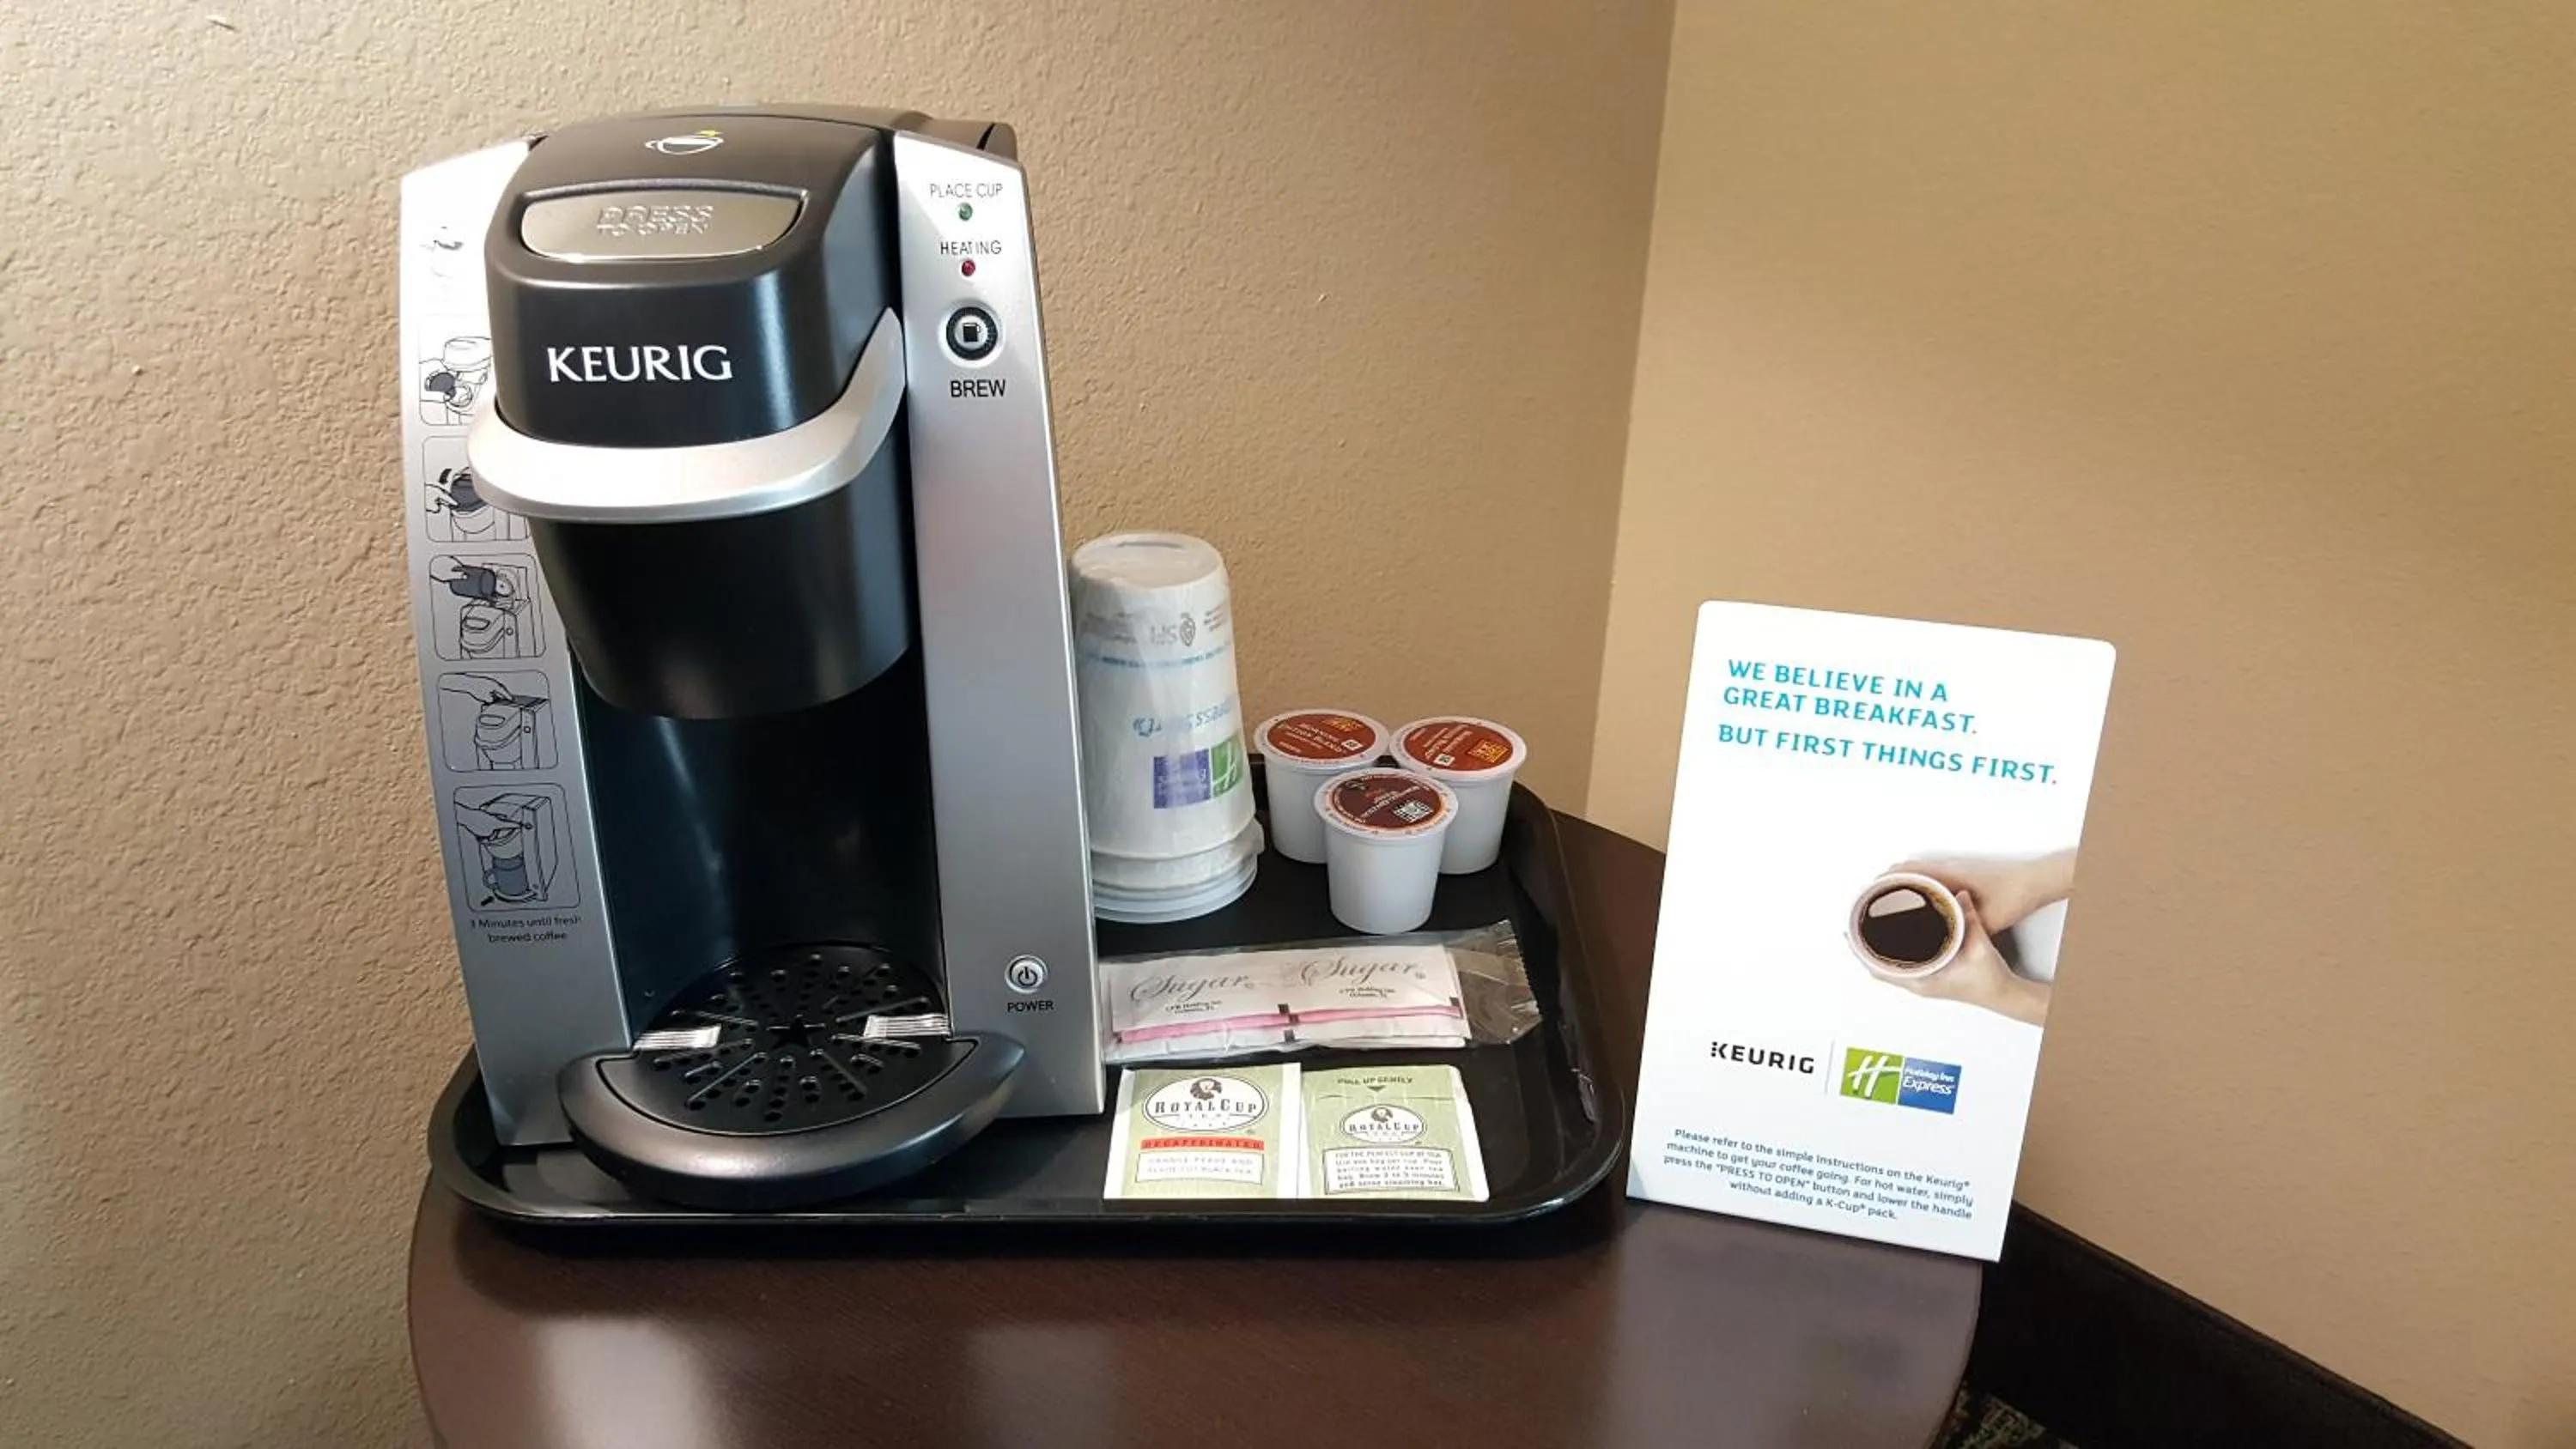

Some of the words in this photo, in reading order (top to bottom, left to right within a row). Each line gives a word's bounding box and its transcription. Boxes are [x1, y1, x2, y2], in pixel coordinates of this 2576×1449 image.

[930, 183, 973, 198] PLACE
[976, 182, 1003, 197] CUP
[940, 240, 1002, 255] HEATING
[547, 345, 733, 382] KEURIG
[950, 379, 1005, 397] BREW
[1728, 658, 1765, 682] WE
[1775, 664, 1884, 694] BELIEVE
[1893, 678, 1923, 699] IN
[1931, 683, 1947, 702] A
[1723, 686, 1807, 712] GREAT
[1815, 696, 1978, 734] BREAKFAST.
[1718, 724, 1768, 747] BUT
[1776, 732, 1855, 758] FIRST
[1862, 742, 1963, 773] THINGS
[1971, 755, 2057, 785] FIRST.
[478, 918, 525, 929] Minutes
[527, 916, 551, 926] until
[487, 932, 532, 943] brewed
[533, 931, 568, 941] coffee
[1301, 955, 1417, 985] Sugar
[1130, 974, 1250, 1003] Sugar
[1007, 999, 1054, 1012] POWER
[1711, 1041, 1814, 1074] KEURIG
[1903, 1076, 1953, 1095] Express
[1155, 1100, 1216, 1113] ROYAL
[1220, 1098, 1257, 1113] CUP
[1675, 1129, 1710, 1143] Please
[1713, 1137, 1739, 1149] refer
[1741, 1141, 1753, 1151] to
[1755, 1144, 1773, 1155] the
[1776, 1149, 1814, 1163] simple
[1816, 1155, 1883, 1175] instructions
[1886, 1169, 1901, 1179] on
[1905, 1171, 1923, 1182] the
[1664, 1155, 1692, 1167] press
[1695, 1160, 1712, 1171] the
[1759, 1171, 1773, 1182] TO
[1813, 1181, 1850, 1197] button
[1853, 1190, 1874, 1202] and
[1878, 1193, 1909, 1207] lower
[1911, 1199, 1929, 1211] the
[1932, 1203, 1972, 1219] handle
[1667, 1142, 1715, 1158] machine
[1717, 1150, 1728, 1161] to
[1731, 1153, 1748, 1165] get
[1752, 1157, 1777, 1169] your
[1779, 1162, 1814, 1176] coffee
[1854, 1175, 1871, 1186] For
[1874, 1178, 1893, 1191] hot
[1934, 1190, 1974, 1208] simply
[1729, 1180, 1771, 1195] without
[1774, 1188, 1814, 1206] adding
[1816, 1197, 1823, 1206] a
[1868, 1205, 1897, 1220] pack.
